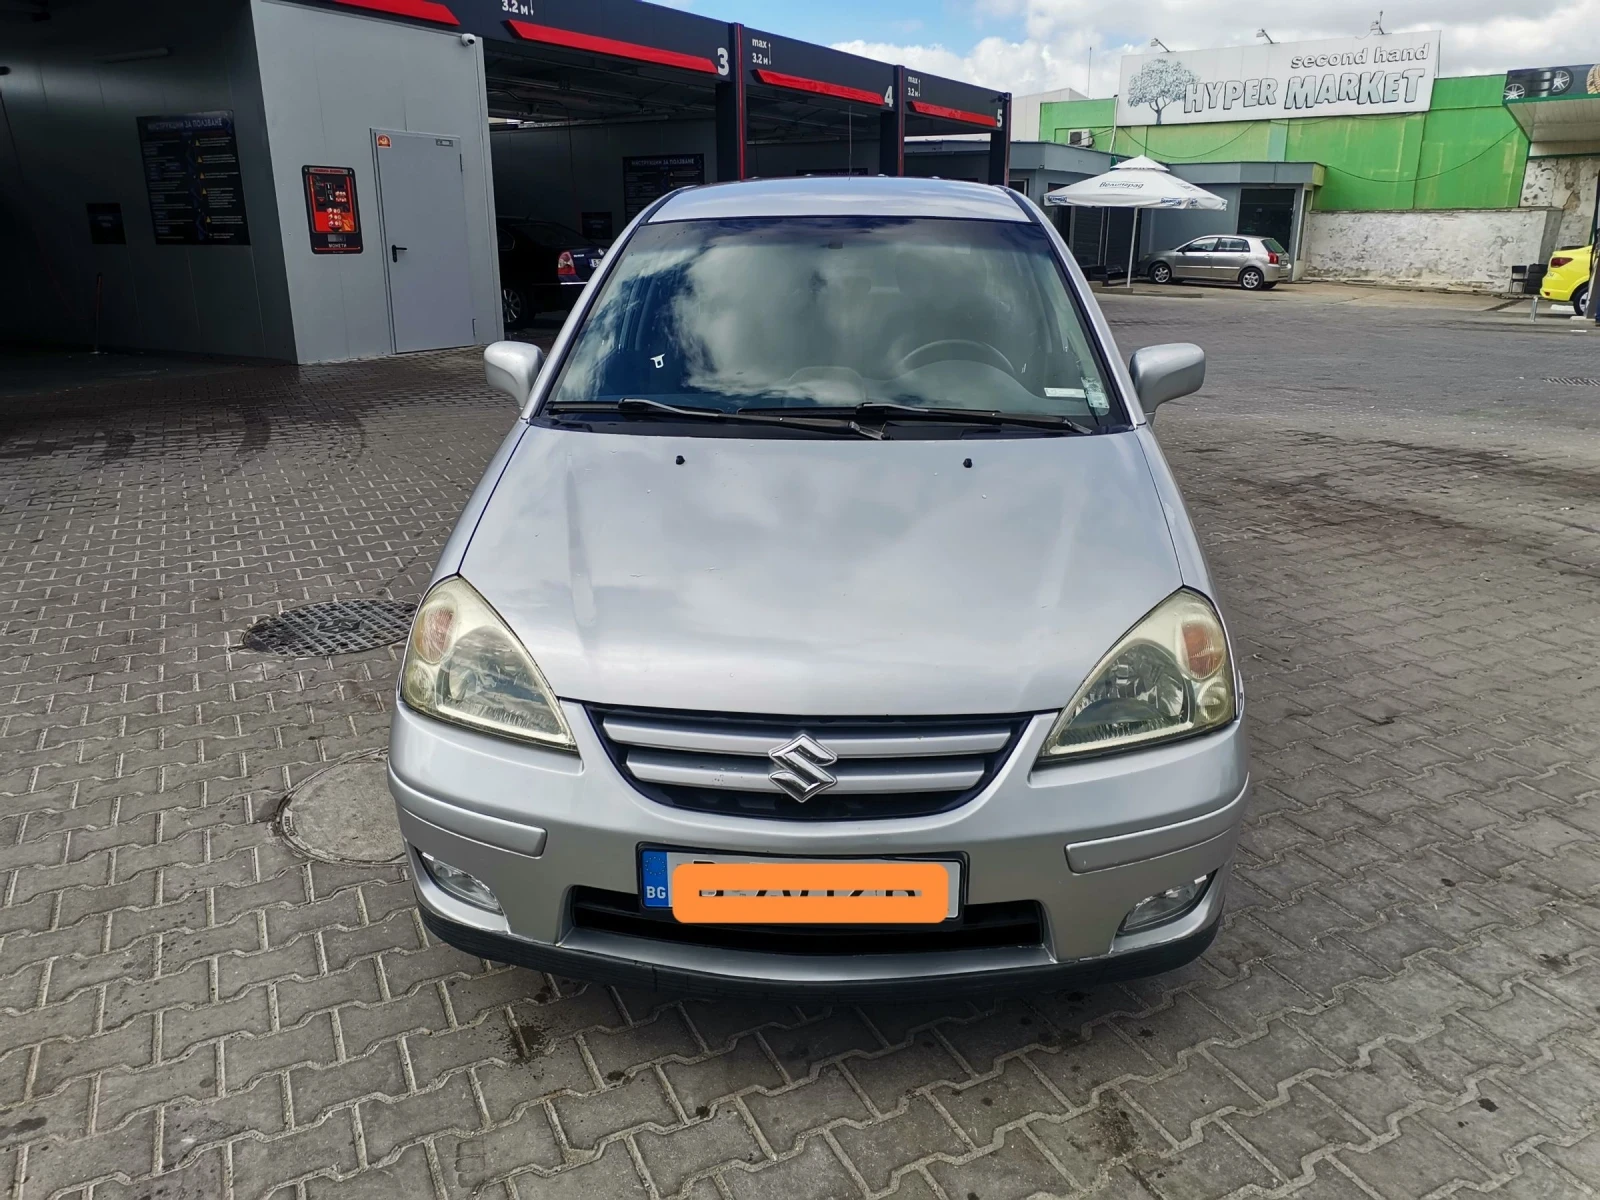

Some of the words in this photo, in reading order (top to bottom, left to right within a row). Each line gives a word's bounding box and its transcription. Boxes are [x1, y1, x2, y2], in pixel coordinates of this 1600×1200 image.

[502, 0, 519, 13] 3.2
[752, 38, 767, 49] max
[717, 47, 729, 76] 3
[752, 52, 762, 65] 3.2
[1291, 48, 1368, 69] second
[1373, 43, 1430, 64] hand
[884, 85, 894, 107] 4
[1184, 78, 1278, 114] HYPER
[1284, 68, 1426, 110] MARKET
[997, 108, 1003, 127] 5
[646, 885, 666, 899] BG
